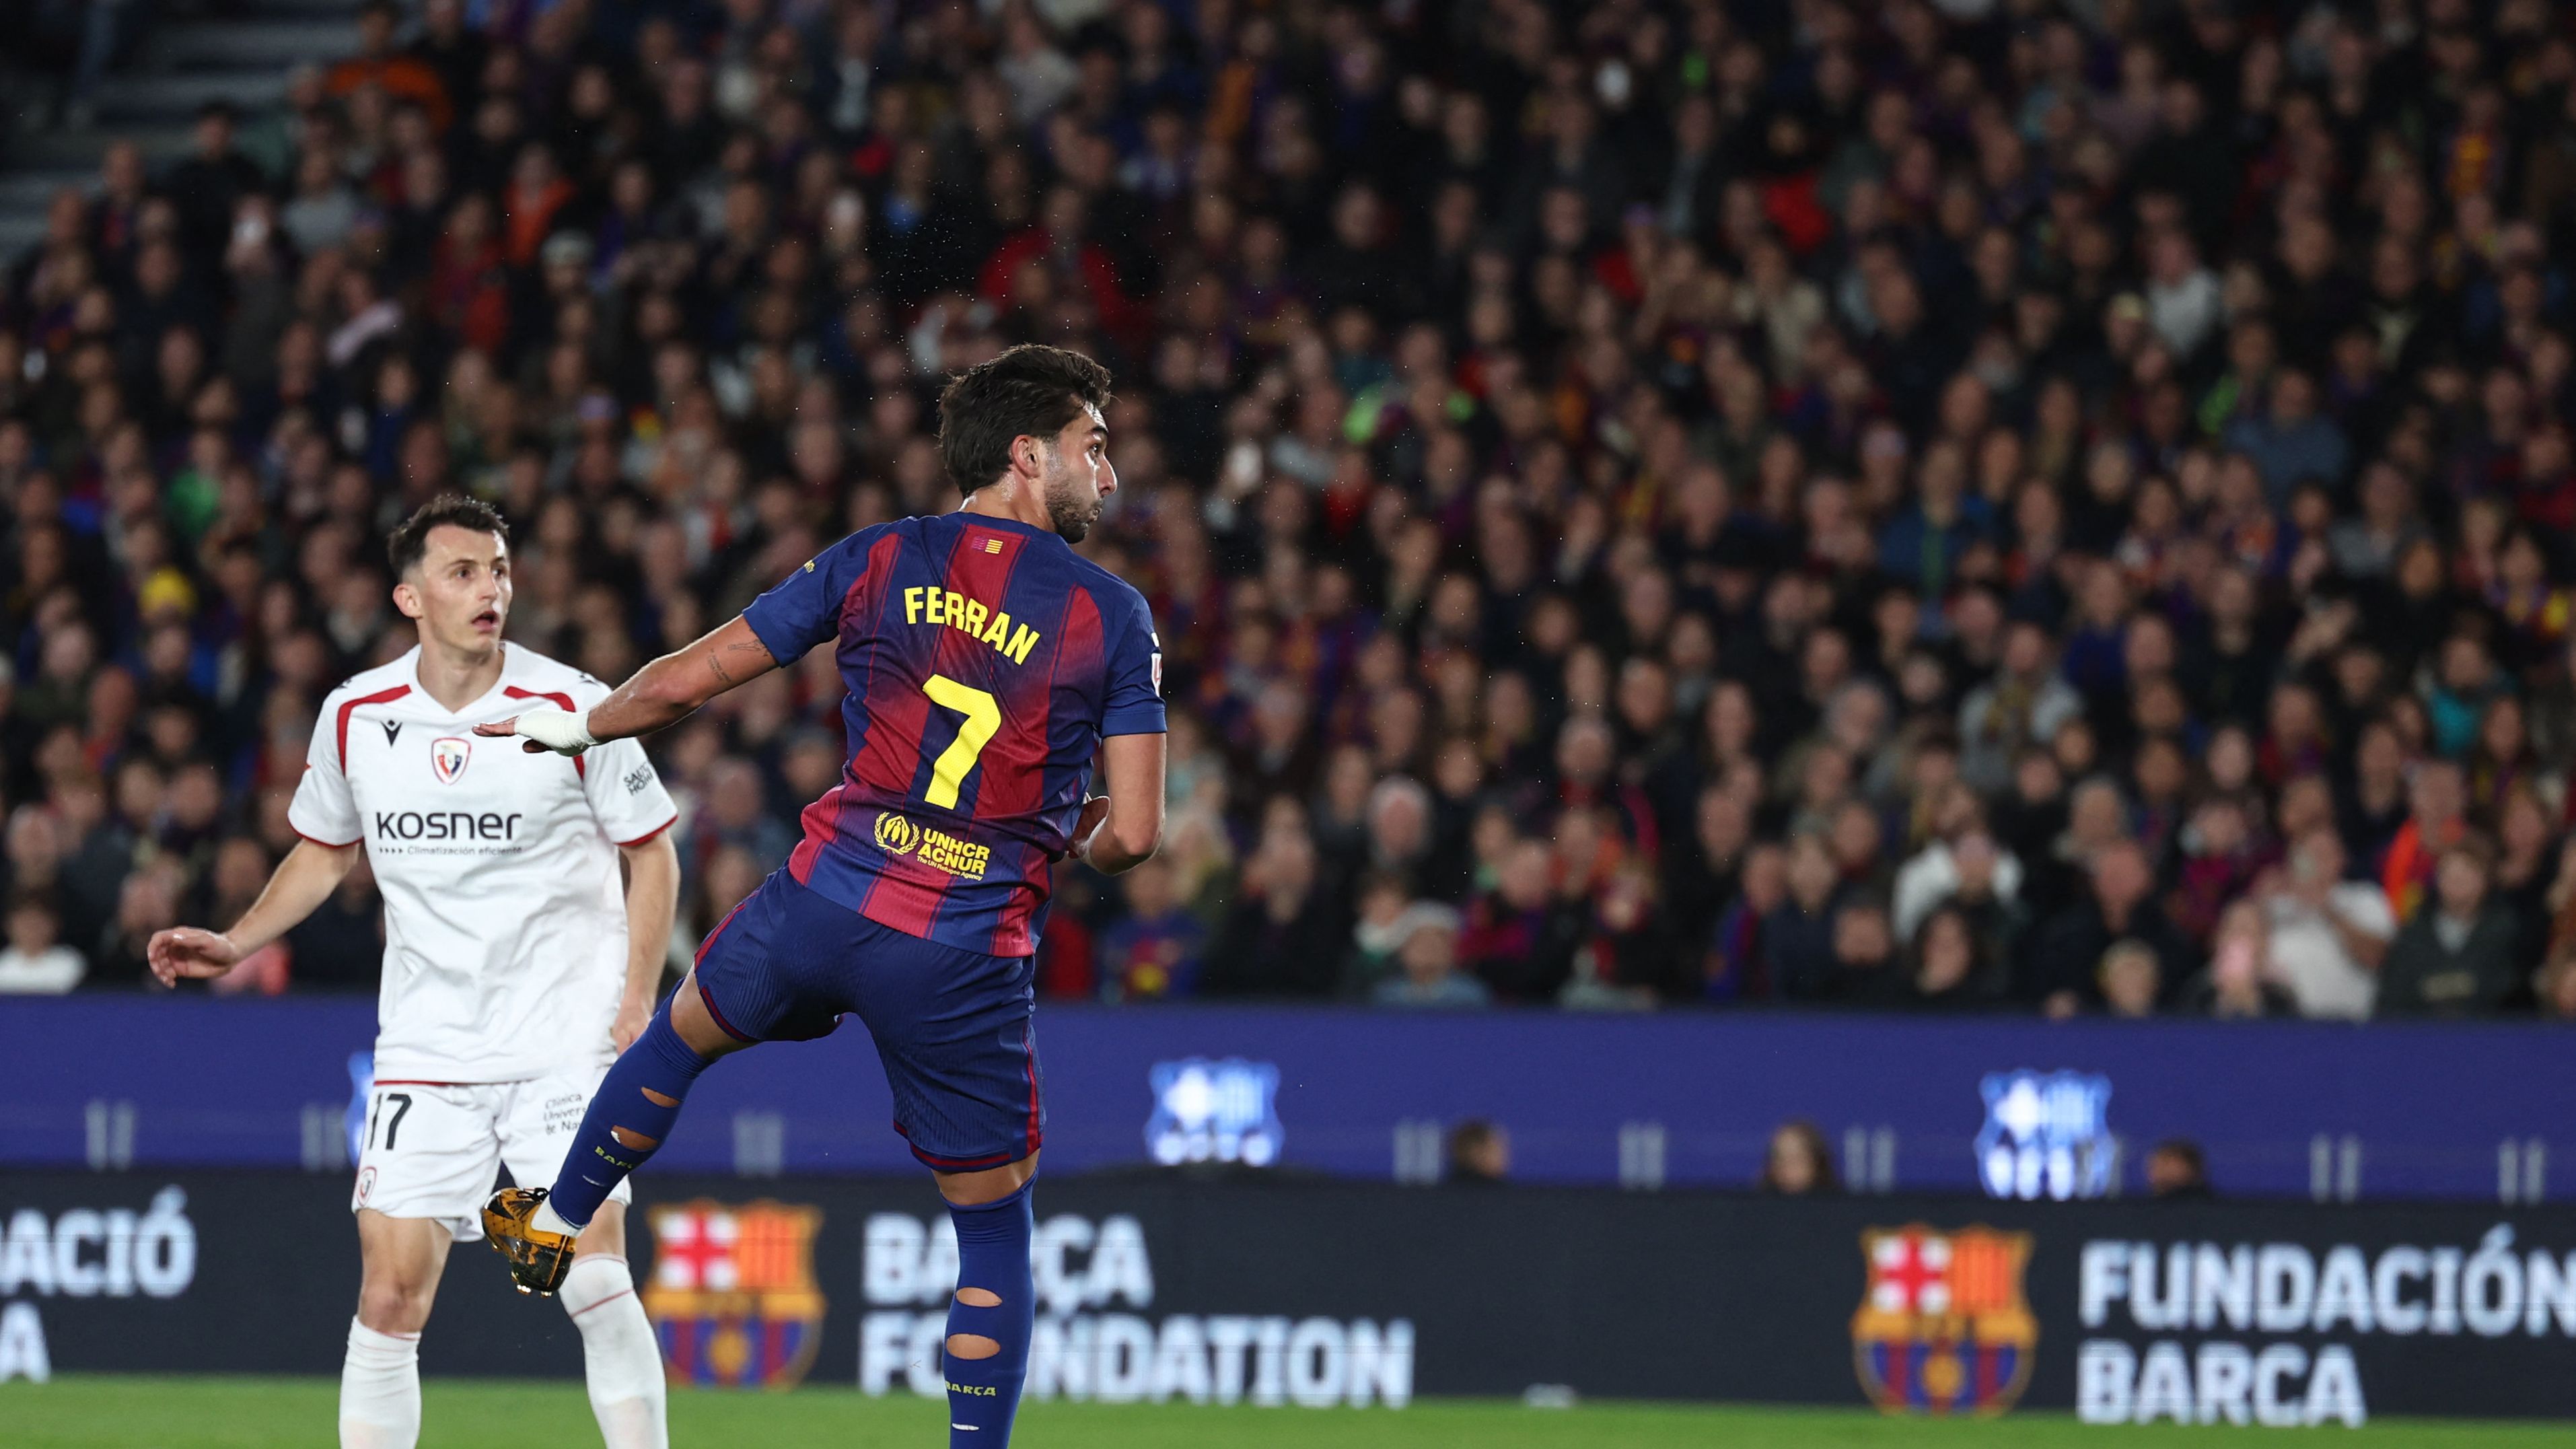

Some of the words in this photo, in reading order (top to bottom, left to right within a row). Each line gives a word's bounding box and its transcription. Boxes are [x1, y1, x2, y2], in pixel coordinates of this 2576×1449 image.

[904, 586, 1040, 666] FERRAN
[922, 674, 1002, 810] 7
[407, 846, 474, 855] Climatización
[478, 846, 522, 856] eficiente
[917, 843, 987, 875] ACNUR
[917, 855, 928, 864] The
[928, 860, 937, 868] UN
[937, 863, 960, 876] Refugee
[961, 872, 982, 881] Agency
[923, 828, 990, 860] UNHCR
[369, 1092, 413, 1150] 17
[0, 1183, 198, 1299] ACIÓ
[862, 1212, 1155, 1316] BAÇA
[2077, 1222, 2576, 1338] FUNDACIÓN
[859, 1312, 1415, 1410] FONDATION
